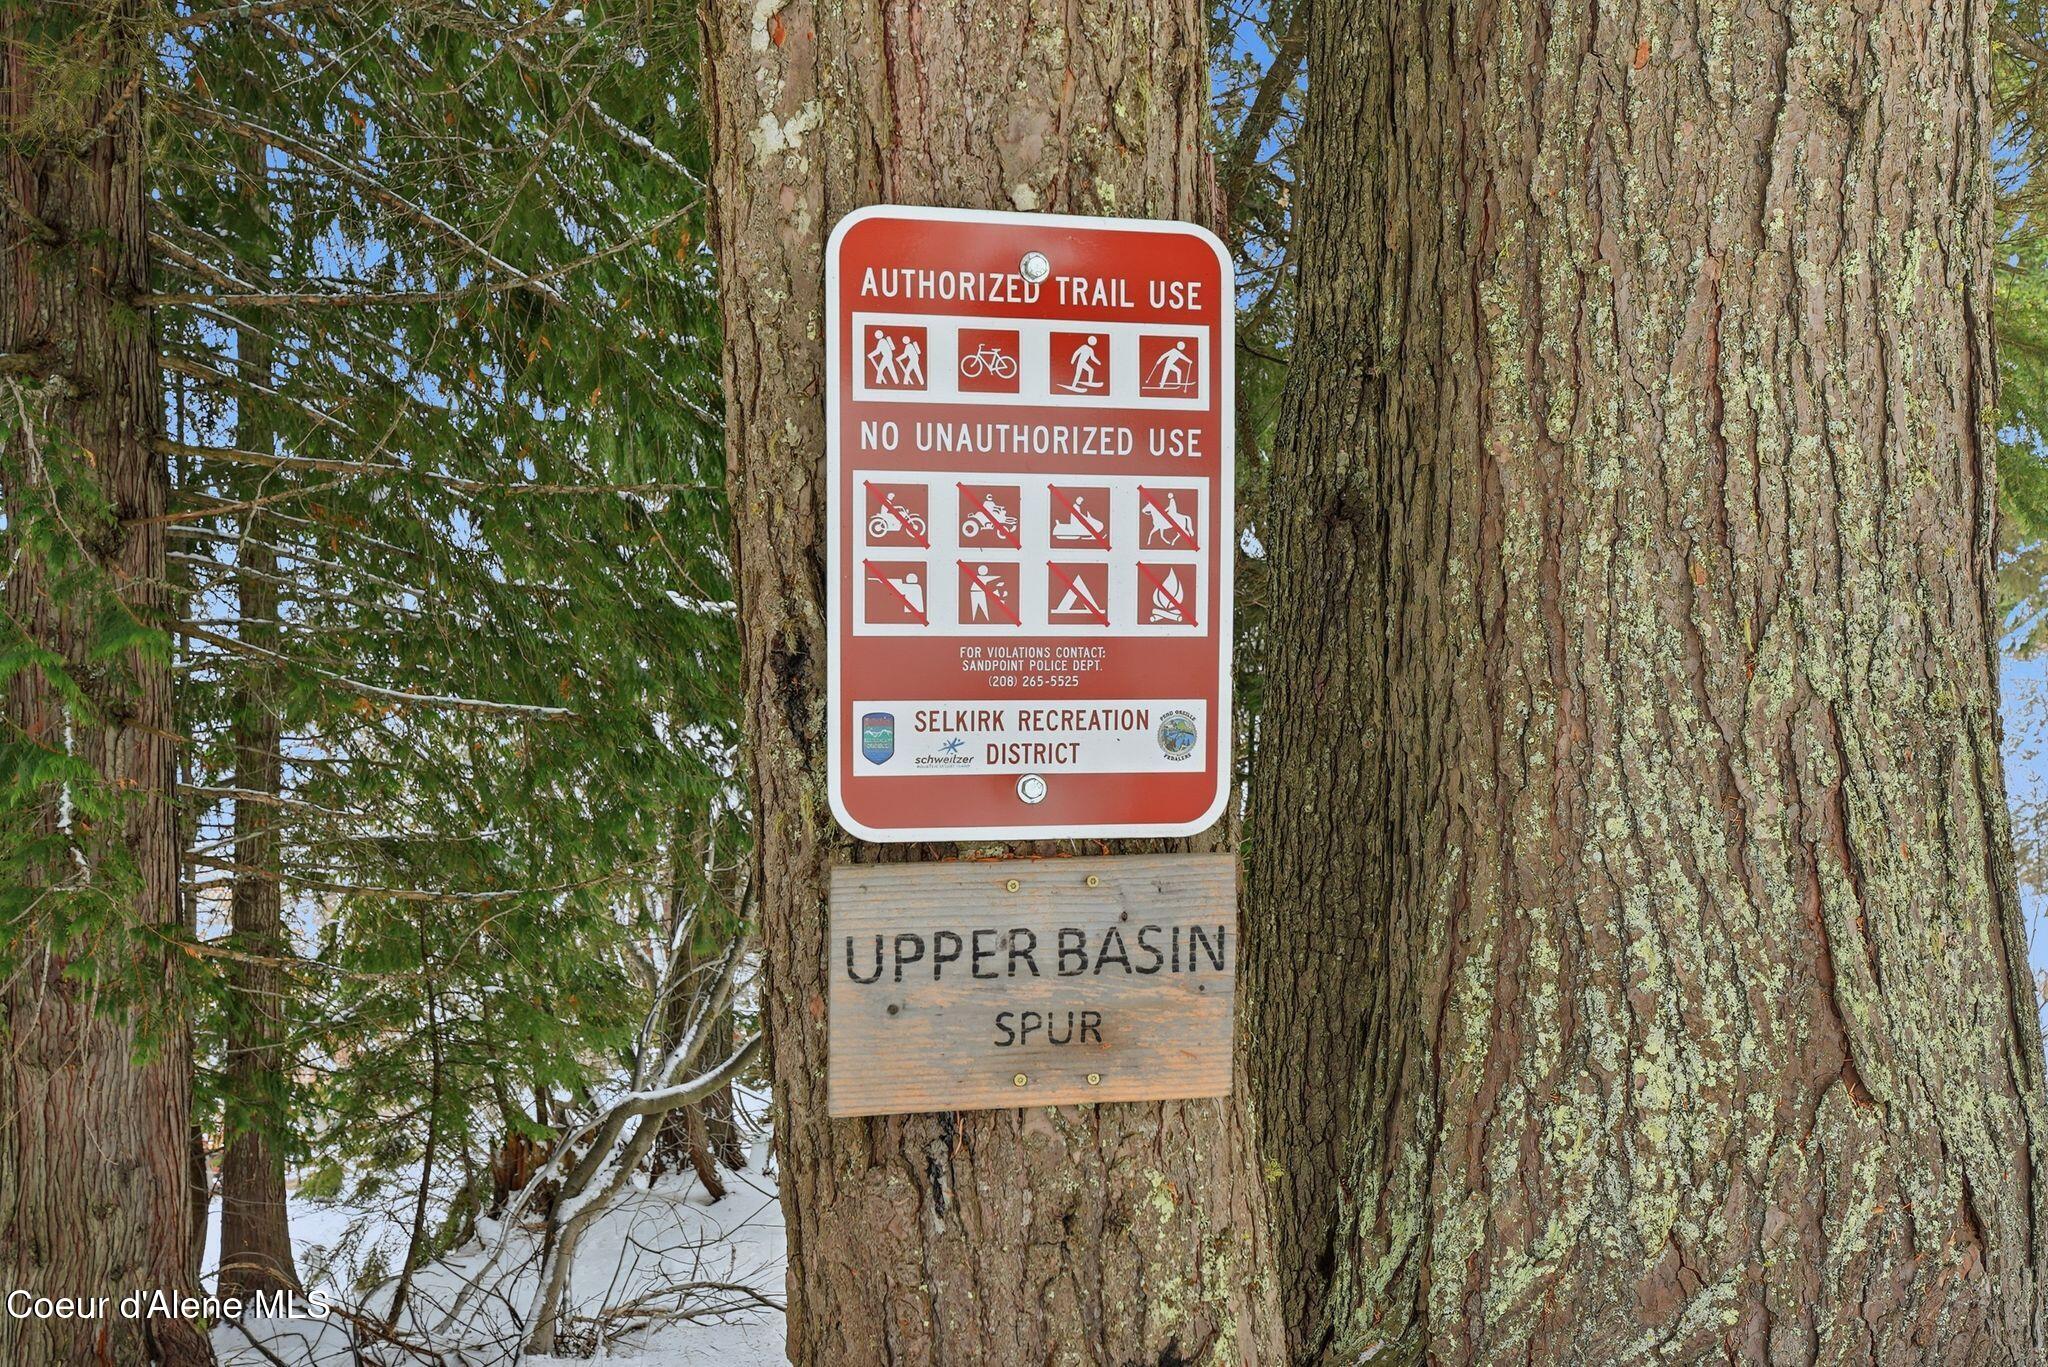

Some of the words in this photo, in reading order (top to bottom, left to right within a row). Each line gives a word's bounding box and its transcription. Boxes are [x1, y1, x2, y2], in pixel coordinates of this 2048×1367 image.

[860, 267, 1040, 304] AUTHORIZED
[1055, 276, 1135, 308] TRAIL
[1149, 280, 1202, 310] USE
[860, 421, 899, 451] NO
[916, 422, 1133, 456] UNAUTHORIZED
[1149, 428, 1202, 457] USE
[960, 646, 982, 658] FOR
[987, 646, 1051, 658] VIOLATIONS
[1055, 646, 1106, 658] CONTACT:
[962, 659, 1024, 671] SANDPOINT
[1029, 659, 1068, 671] POLICE
[1073, 659, 1103, 671] DEPT.
[988, 675, 1018, 687] (208)
[1022, 675, 1079, 687] 265-5525
[914, 710, 1005, 733] SELKIRK
[1018, 709, 1150, 732] RECREATION
[914, 754, 975, 765] schweitzer
[986, 742, 1081, 765] DISTRICT
[845, 928, 1040, 984] UPPER
[1057, 924, 1225, 976] BASIN
[994, 1011, 1103, 1047] SPUR
